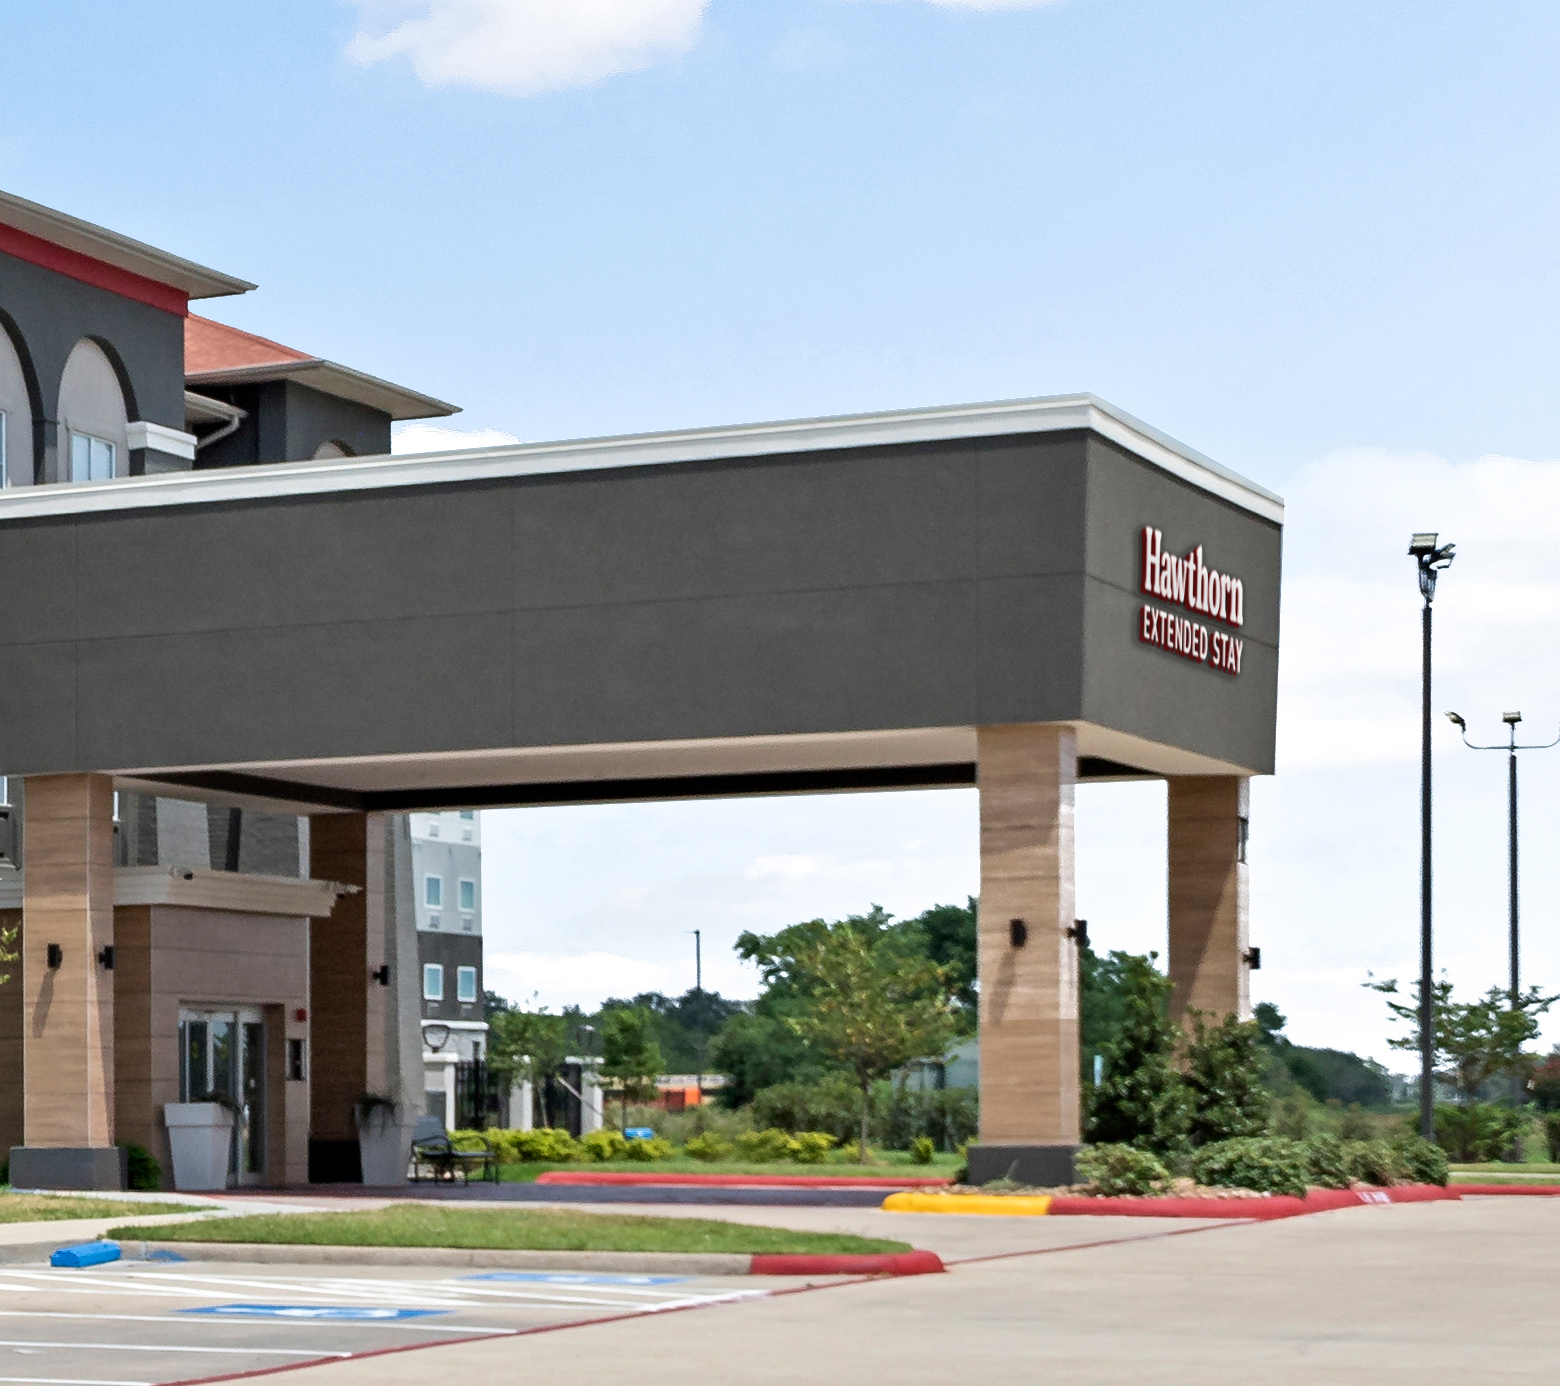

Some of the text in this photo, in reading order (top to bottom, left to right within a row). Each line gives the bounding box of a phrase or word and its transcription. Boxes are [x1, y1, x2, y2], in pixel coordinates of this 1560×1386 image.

[1142, 525, 1244, 627] Hawthorn
[1141, 604, 1244, 676] EXTENDED STAY
